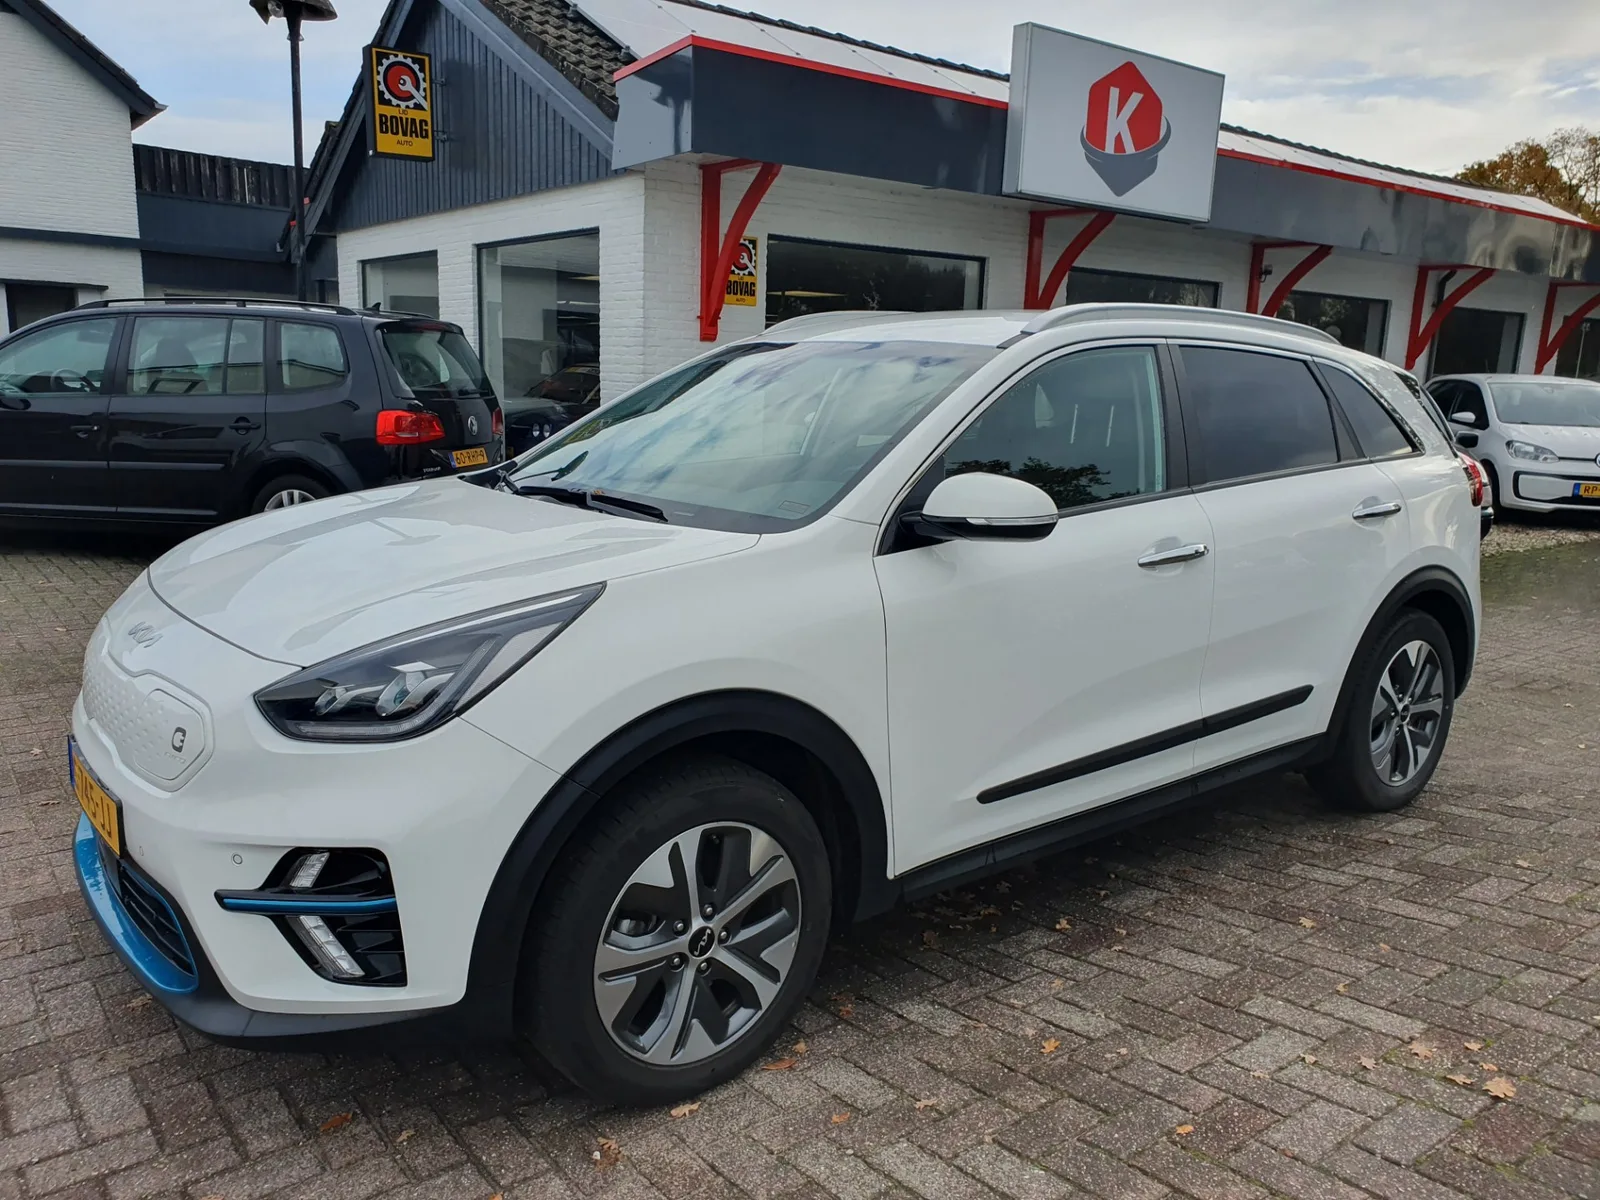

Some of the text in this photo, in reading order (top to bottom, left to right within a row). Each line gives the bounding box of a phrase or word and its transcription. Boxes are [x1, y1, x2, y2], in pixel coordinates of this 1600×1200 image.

[379, 113, 429, 140] BOVAG
[1104, 86, 1144, 154] K
[726, 279, 756, 297] BOVAG
